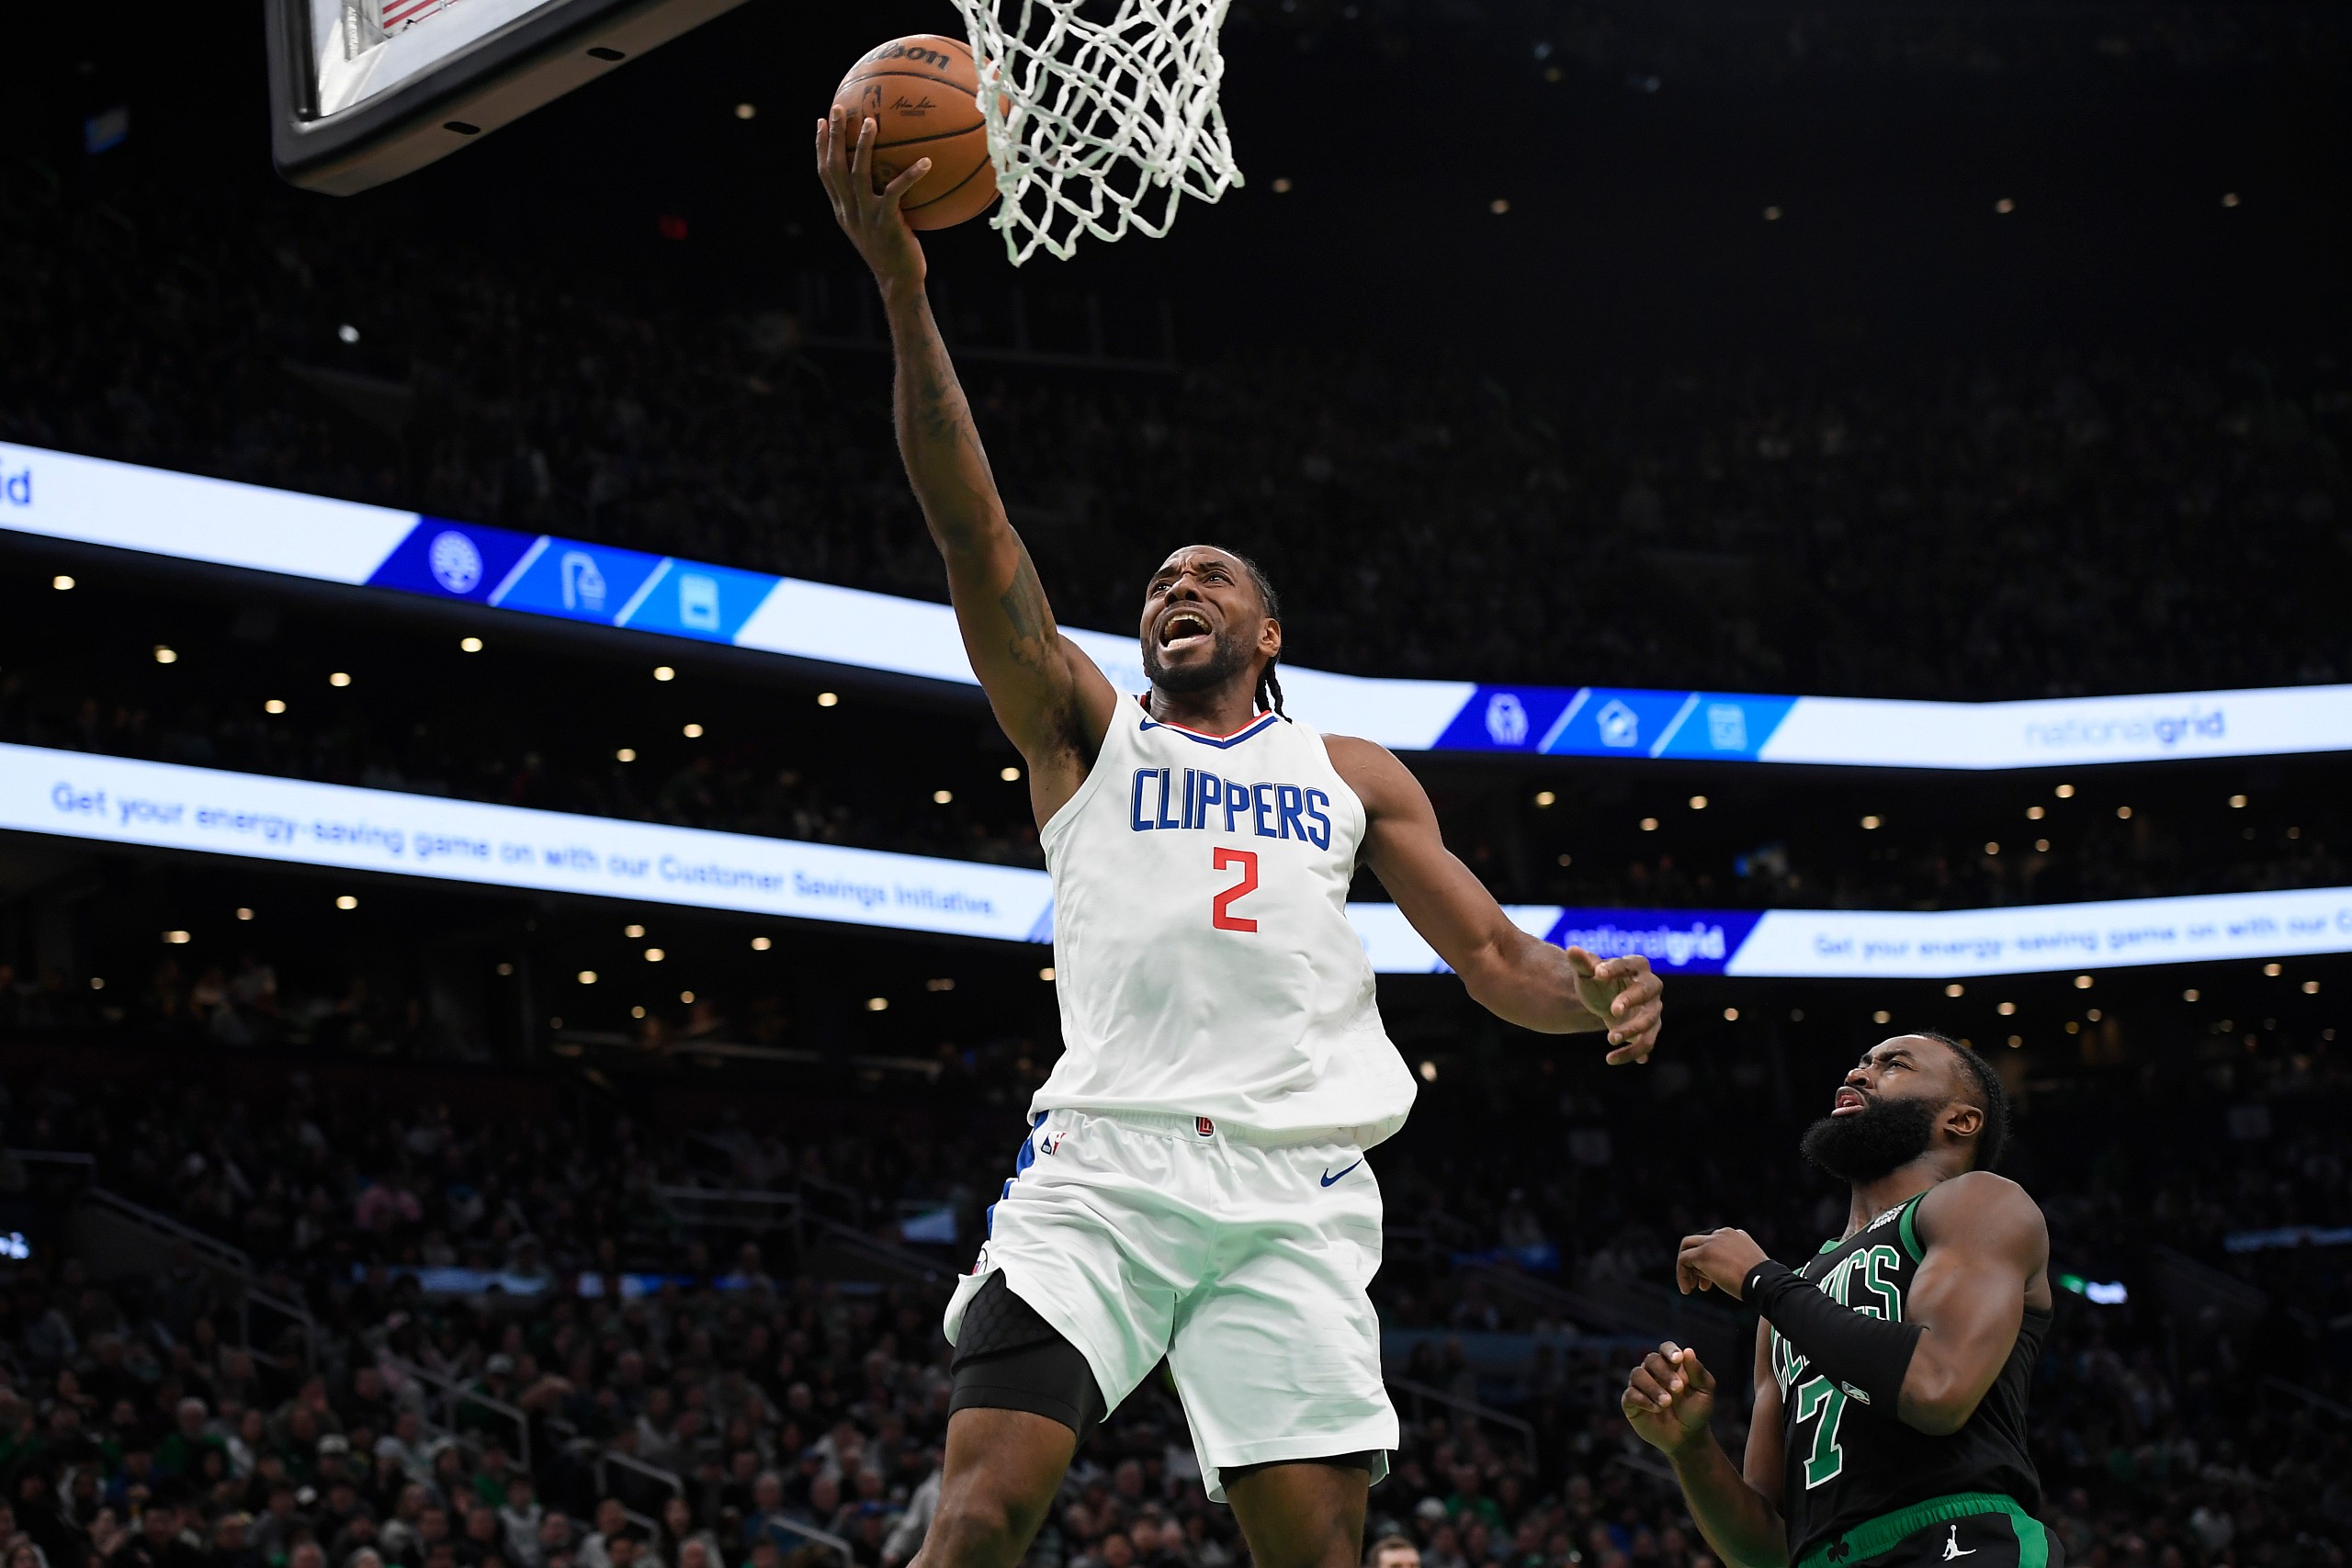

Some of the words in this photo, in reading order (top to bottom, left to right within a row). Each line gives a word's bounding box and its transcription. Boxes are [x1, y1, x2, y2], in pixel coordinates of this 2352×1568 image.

[52, 782, 107, 815] Get
[117, 795, 184, 828] your
[413, 831, 489, 861] game
[502, 842, 536, 864] on
[544, 845, 597, 871] with
[606, 853, 650, 876] our
[659, 853, 785, 893] Customer
[794, 872, 887, 909] Savings
[1130, 767, 1331, 852] CLIPPERS
[1213, 847, 1258, 932] 2
[1796, 1374, 1848, 1490] 7
